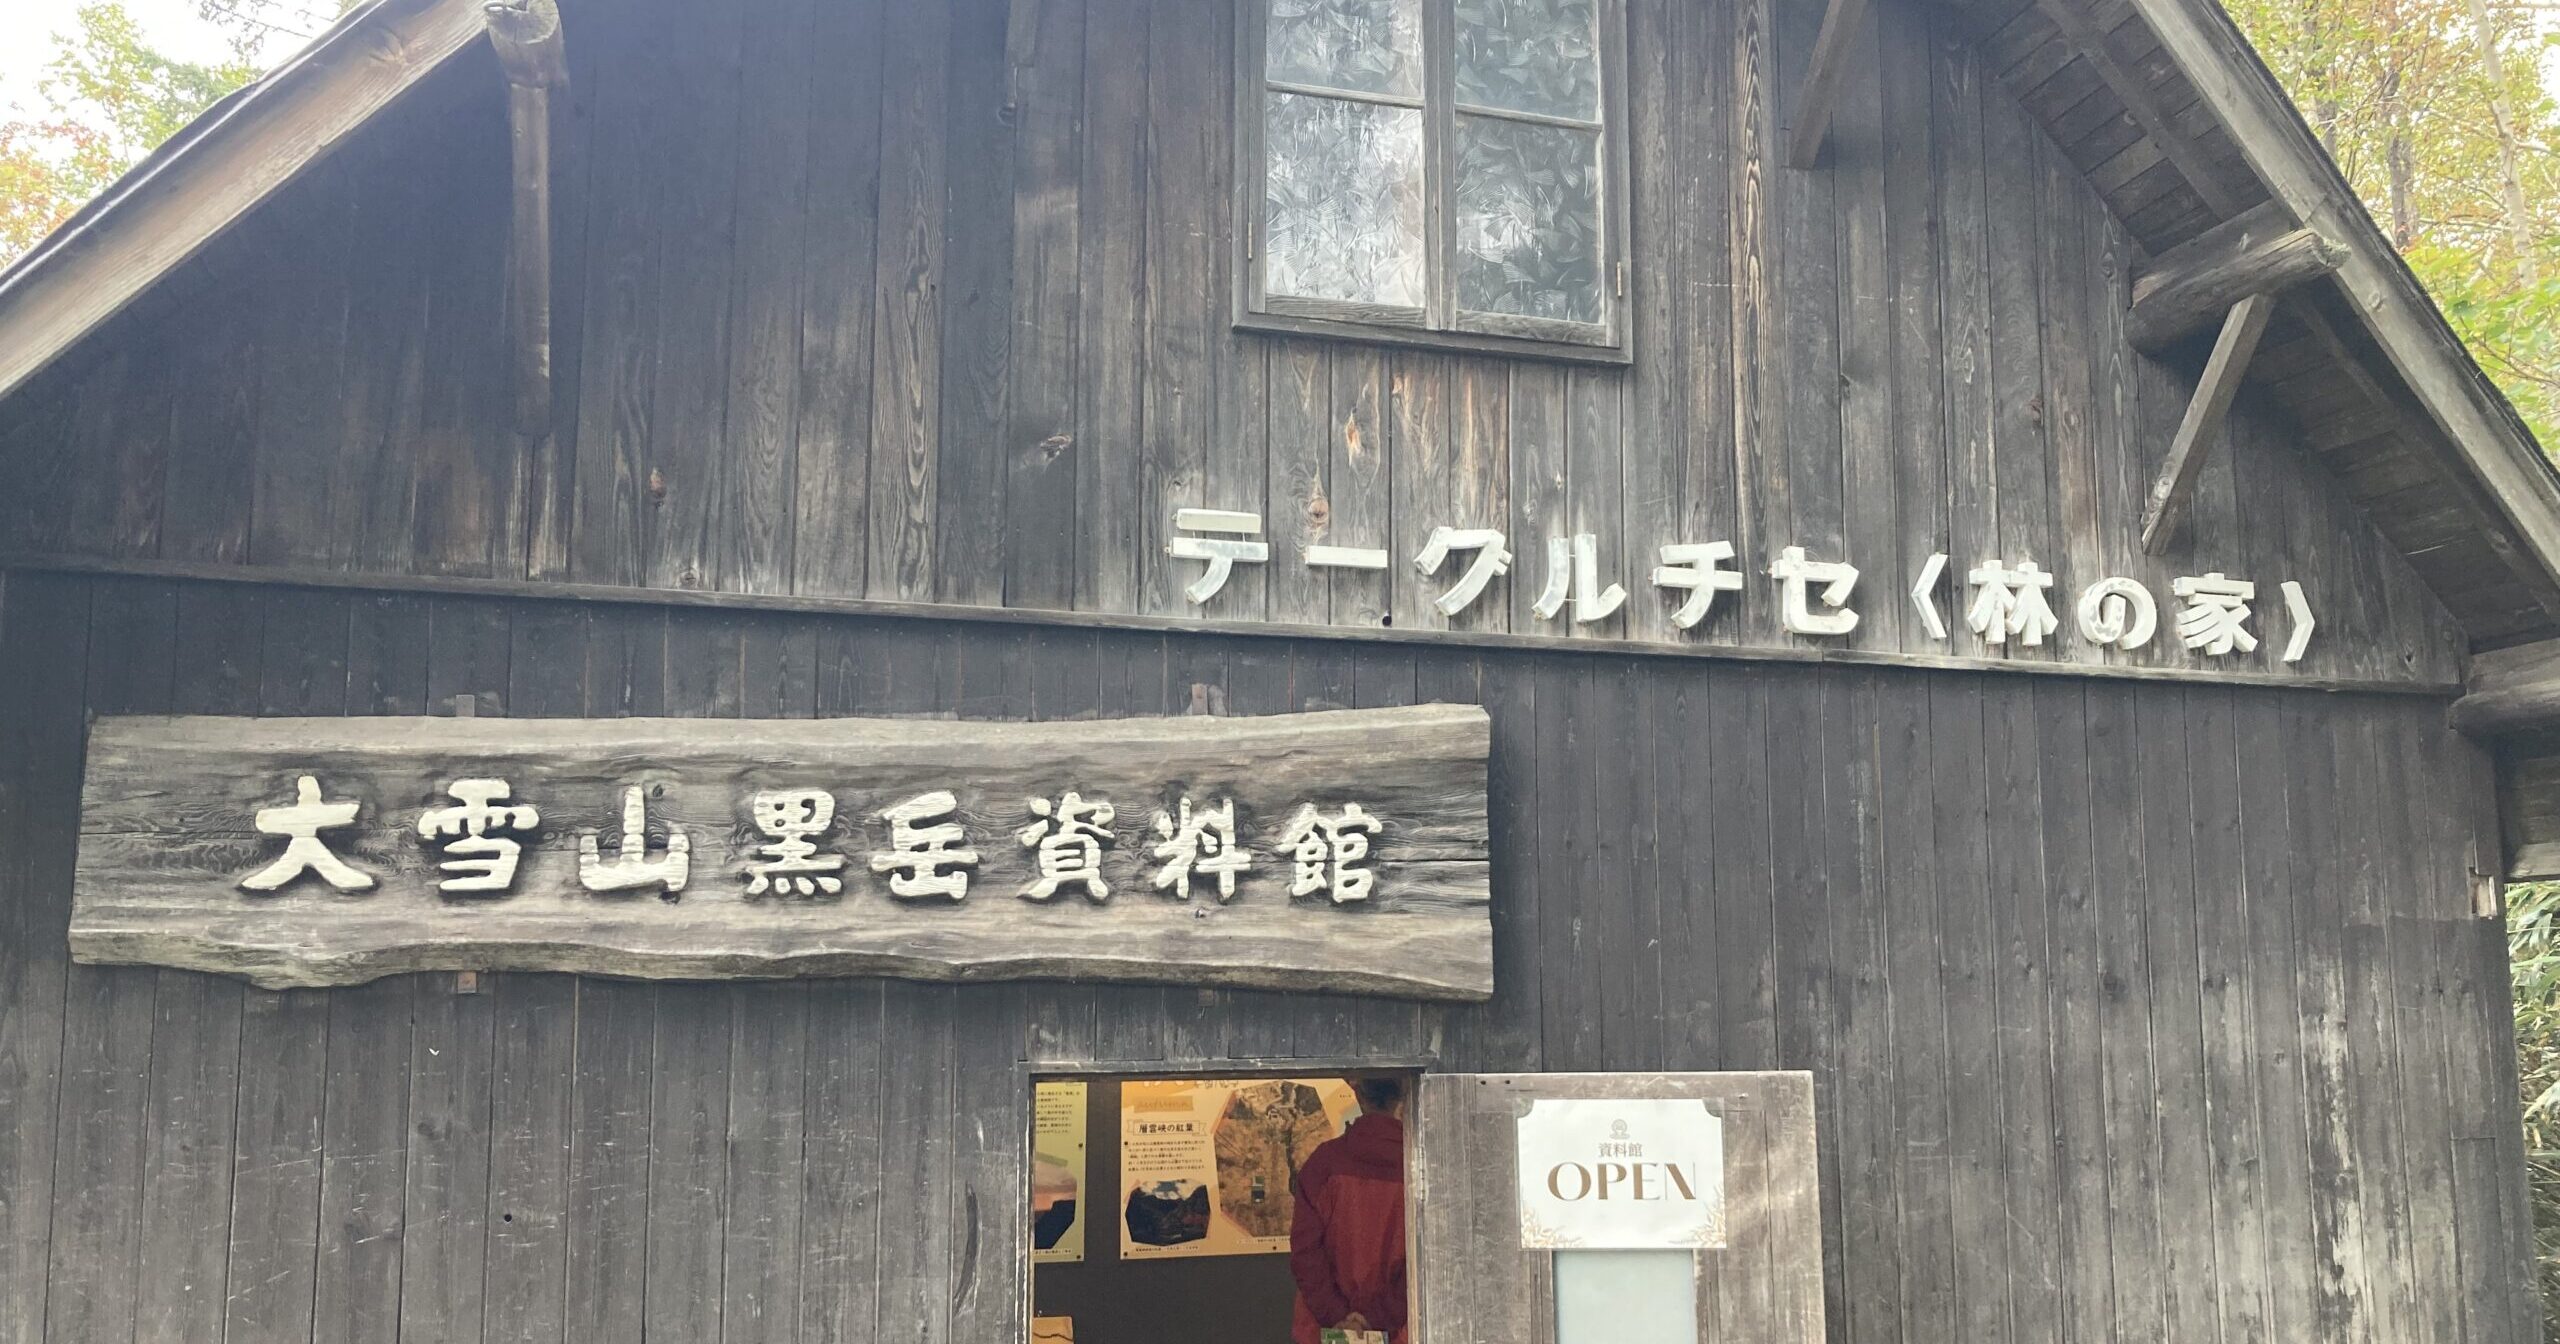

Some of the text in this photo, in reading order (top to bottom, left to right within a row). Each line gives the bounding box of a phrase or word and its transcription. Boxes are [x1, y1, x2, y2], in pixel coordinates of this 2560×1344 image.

[240, 775, 1382, 903] 大雪山黒岳資料館
[1139, 1123, 1194, 1134] 層雲峡の紅葉
[1598, 1142, 1643, 1158] 資料館
[1547, 1161, 1697, 1202] OPEN
